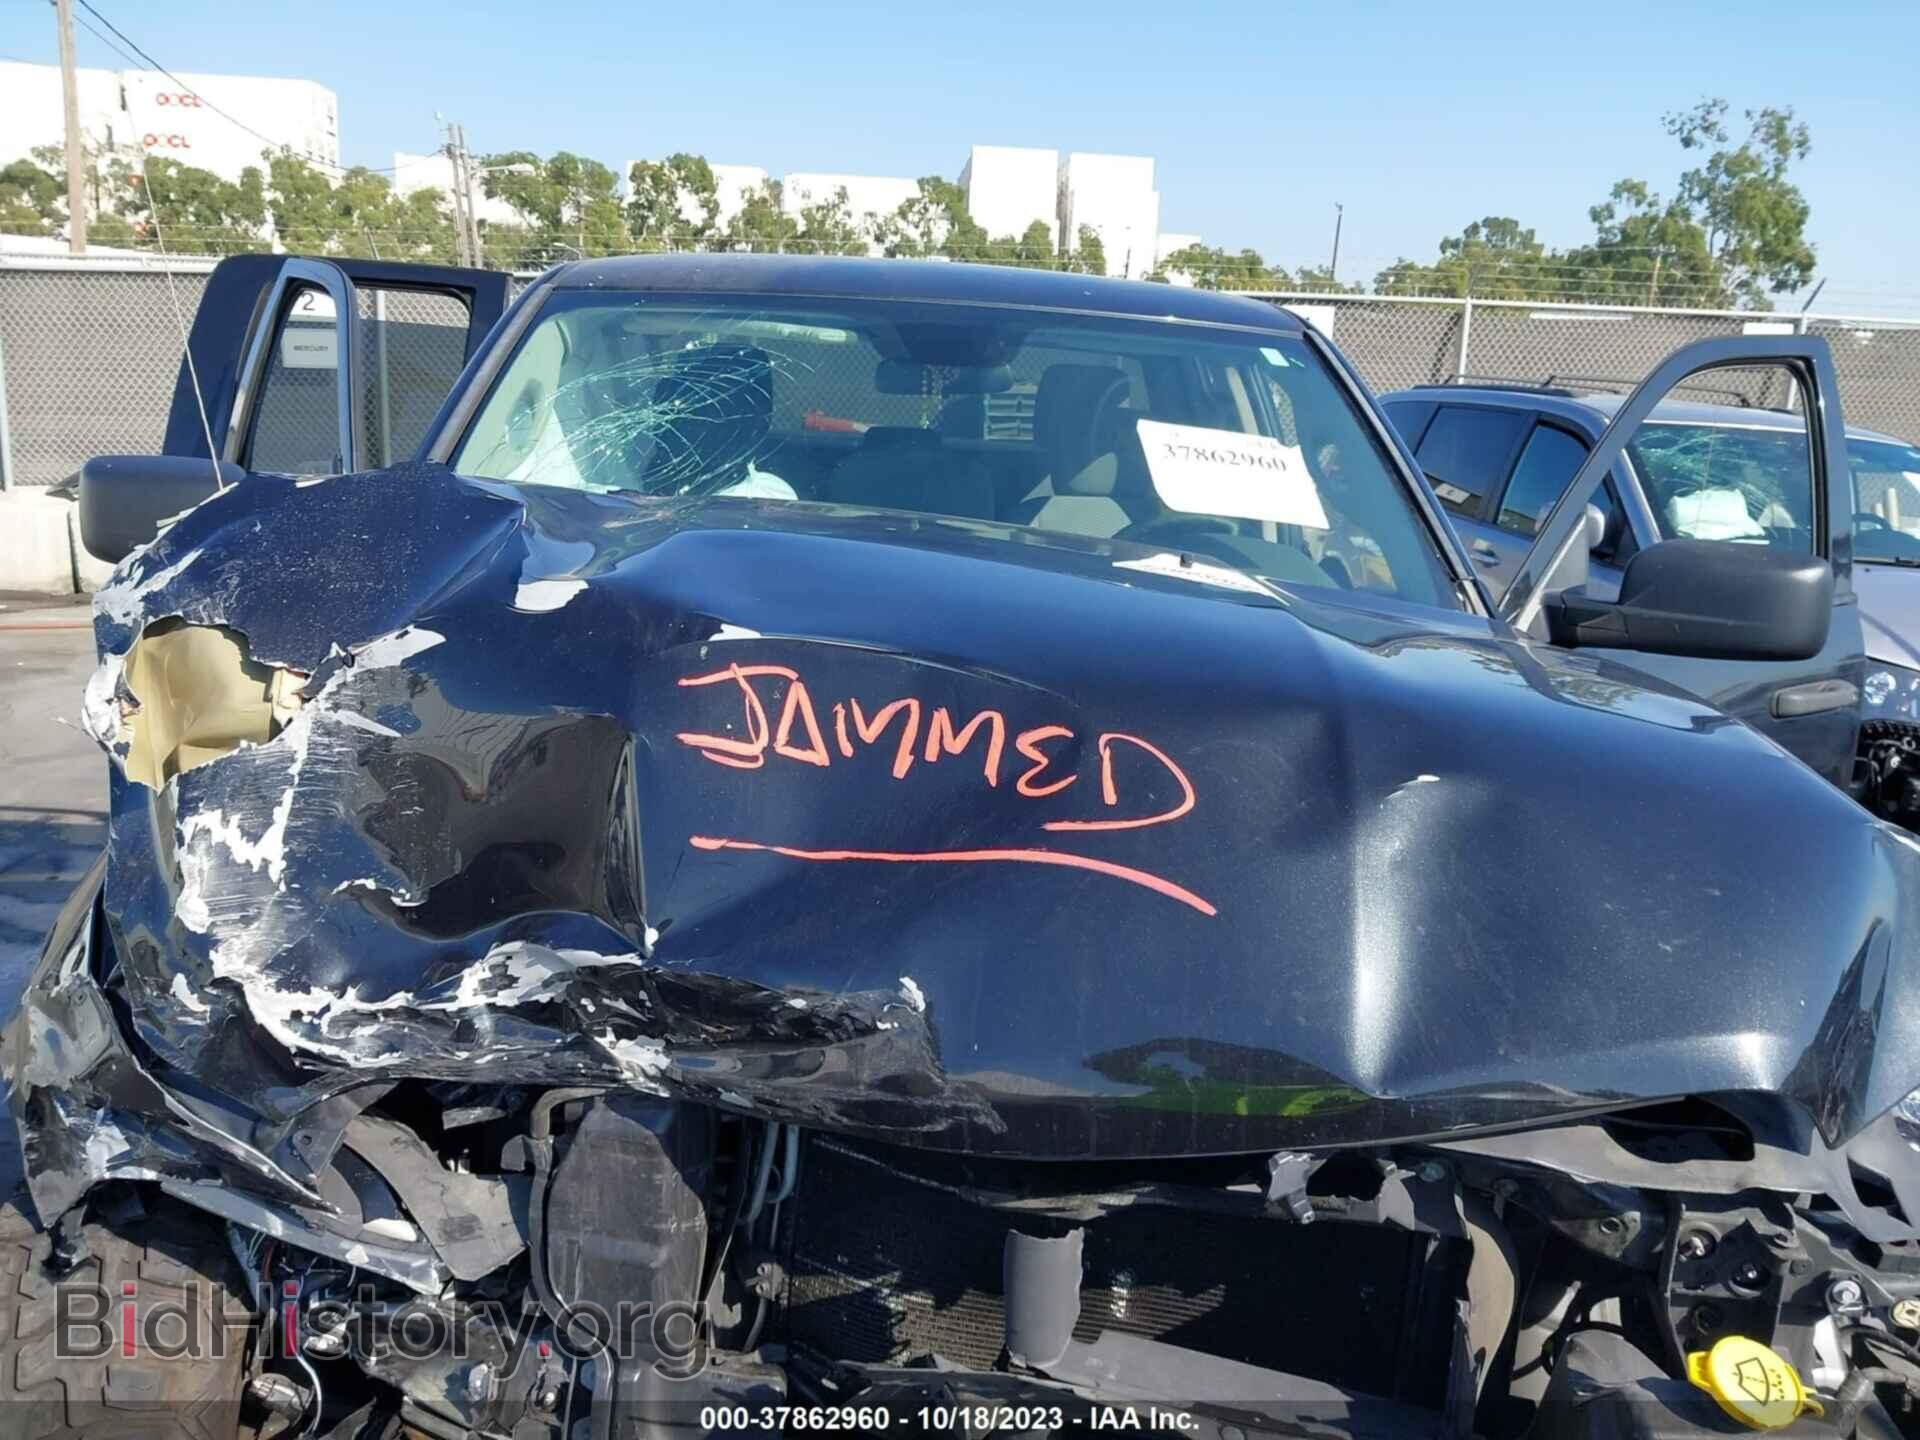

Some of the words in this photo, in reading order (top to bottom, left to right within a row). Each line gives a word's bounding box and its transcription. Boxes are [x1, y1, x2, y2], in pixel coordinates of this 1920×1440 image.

[303, 292, 315, 311] 2
[1162, 443, 1288, 472] 37862960
[677, 662, 1197, 832] JAMMED
